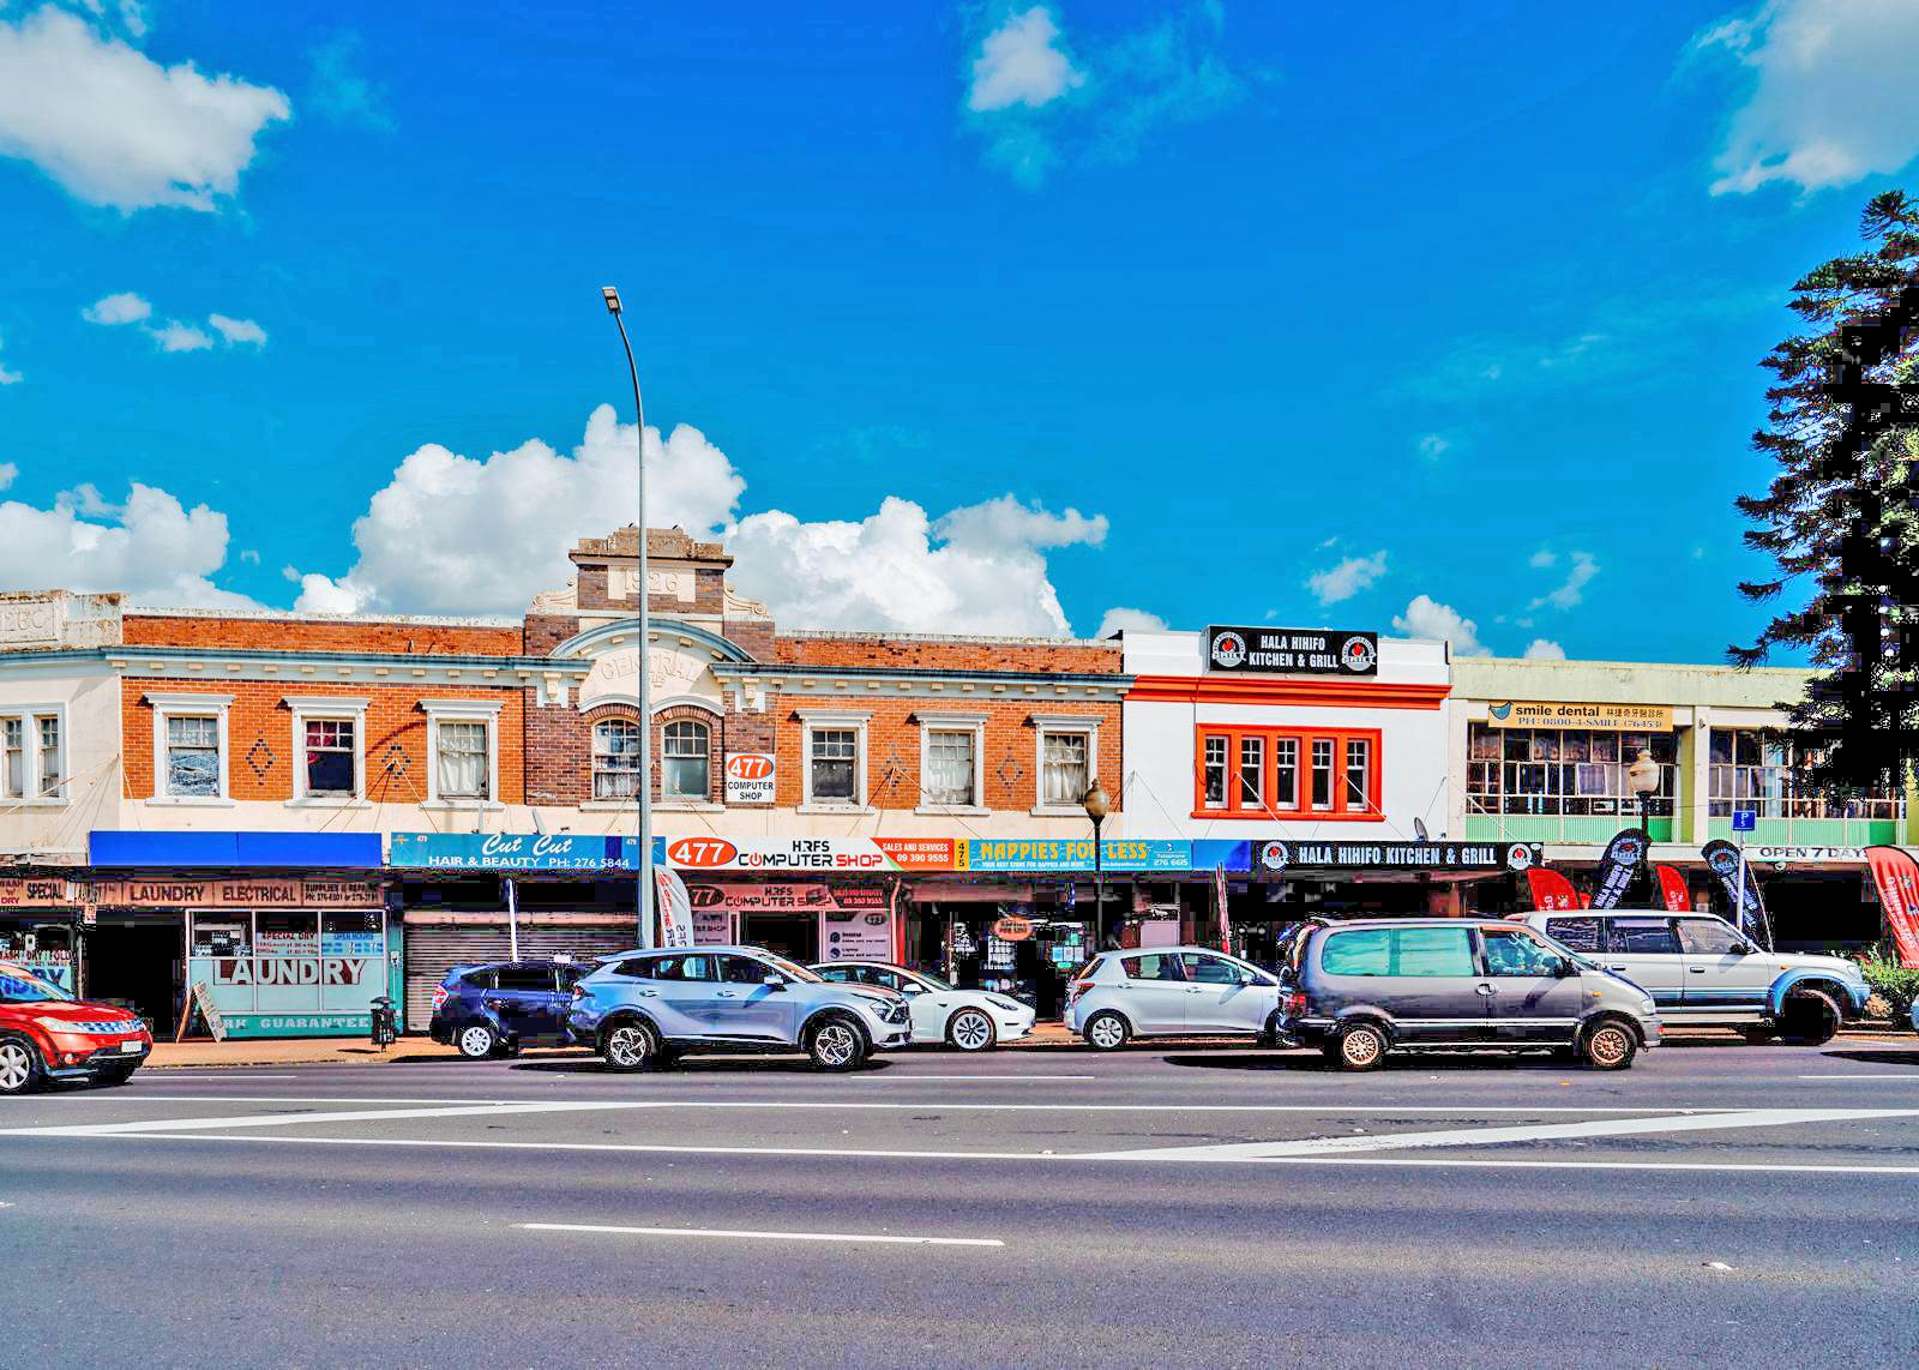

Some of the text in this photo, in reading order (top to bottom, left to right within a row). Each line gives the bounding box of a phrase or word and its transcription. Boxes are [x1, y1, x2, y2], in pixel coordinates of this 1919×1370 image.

[1261, 635, 1288, 650] HALA
[1291, 636, 1326, 651] HIHIFO
[1249, 652, 1339, 668] KITCHEN & GRILL
[1516, 704, 1600, 717] smile dental
[731, 758, 767, 777] 477
[727, 781, 774, 790] COMPUTER
[739, 791, 762, 800] SHOP
[1740, 812, 1749, 820] P
[482, 834, 573, 855] Cut Cut
[792, 840, 830, 852] HRFS
[882, 843, 949, 852] SALES AND SERVICES
[981, 842, 1059, 860] NAPPIES
[1106, 842, 1148, 860] LESS
[675, 842, 726, 863] 477
[896, 853, 949, 862] 09 390 9555
[1299, 847, 1333, 864] HALA
[1338, 847, 1381, 864] HIHIFO
[1386, 847, 1440, 864] KITCHEN
[1446, 848, 1456, 864] &
[1461, 848, 1497, 865] GRILL
[1760, 847, 1808, 858] OPEN
[1811, 847, 1824, 858] 7
[429, 856, 630, 869] HAIR & BEAUTY PH: 276 5844
[738, 853, 883, 867] COMPUTER SHOP
[130, 886, 204, 901] LAUNDRY
[223, 886, 296, 901] ELECTRICAL
[692, 888, 717, 905] 77
[764, 887, 793, 896] HRFS
[725, 895, 795, 907] COMPUTER
[214, 959, 367, 985] LAUNDRY
[260, 1017, 369, 1028] GUARANTEE
